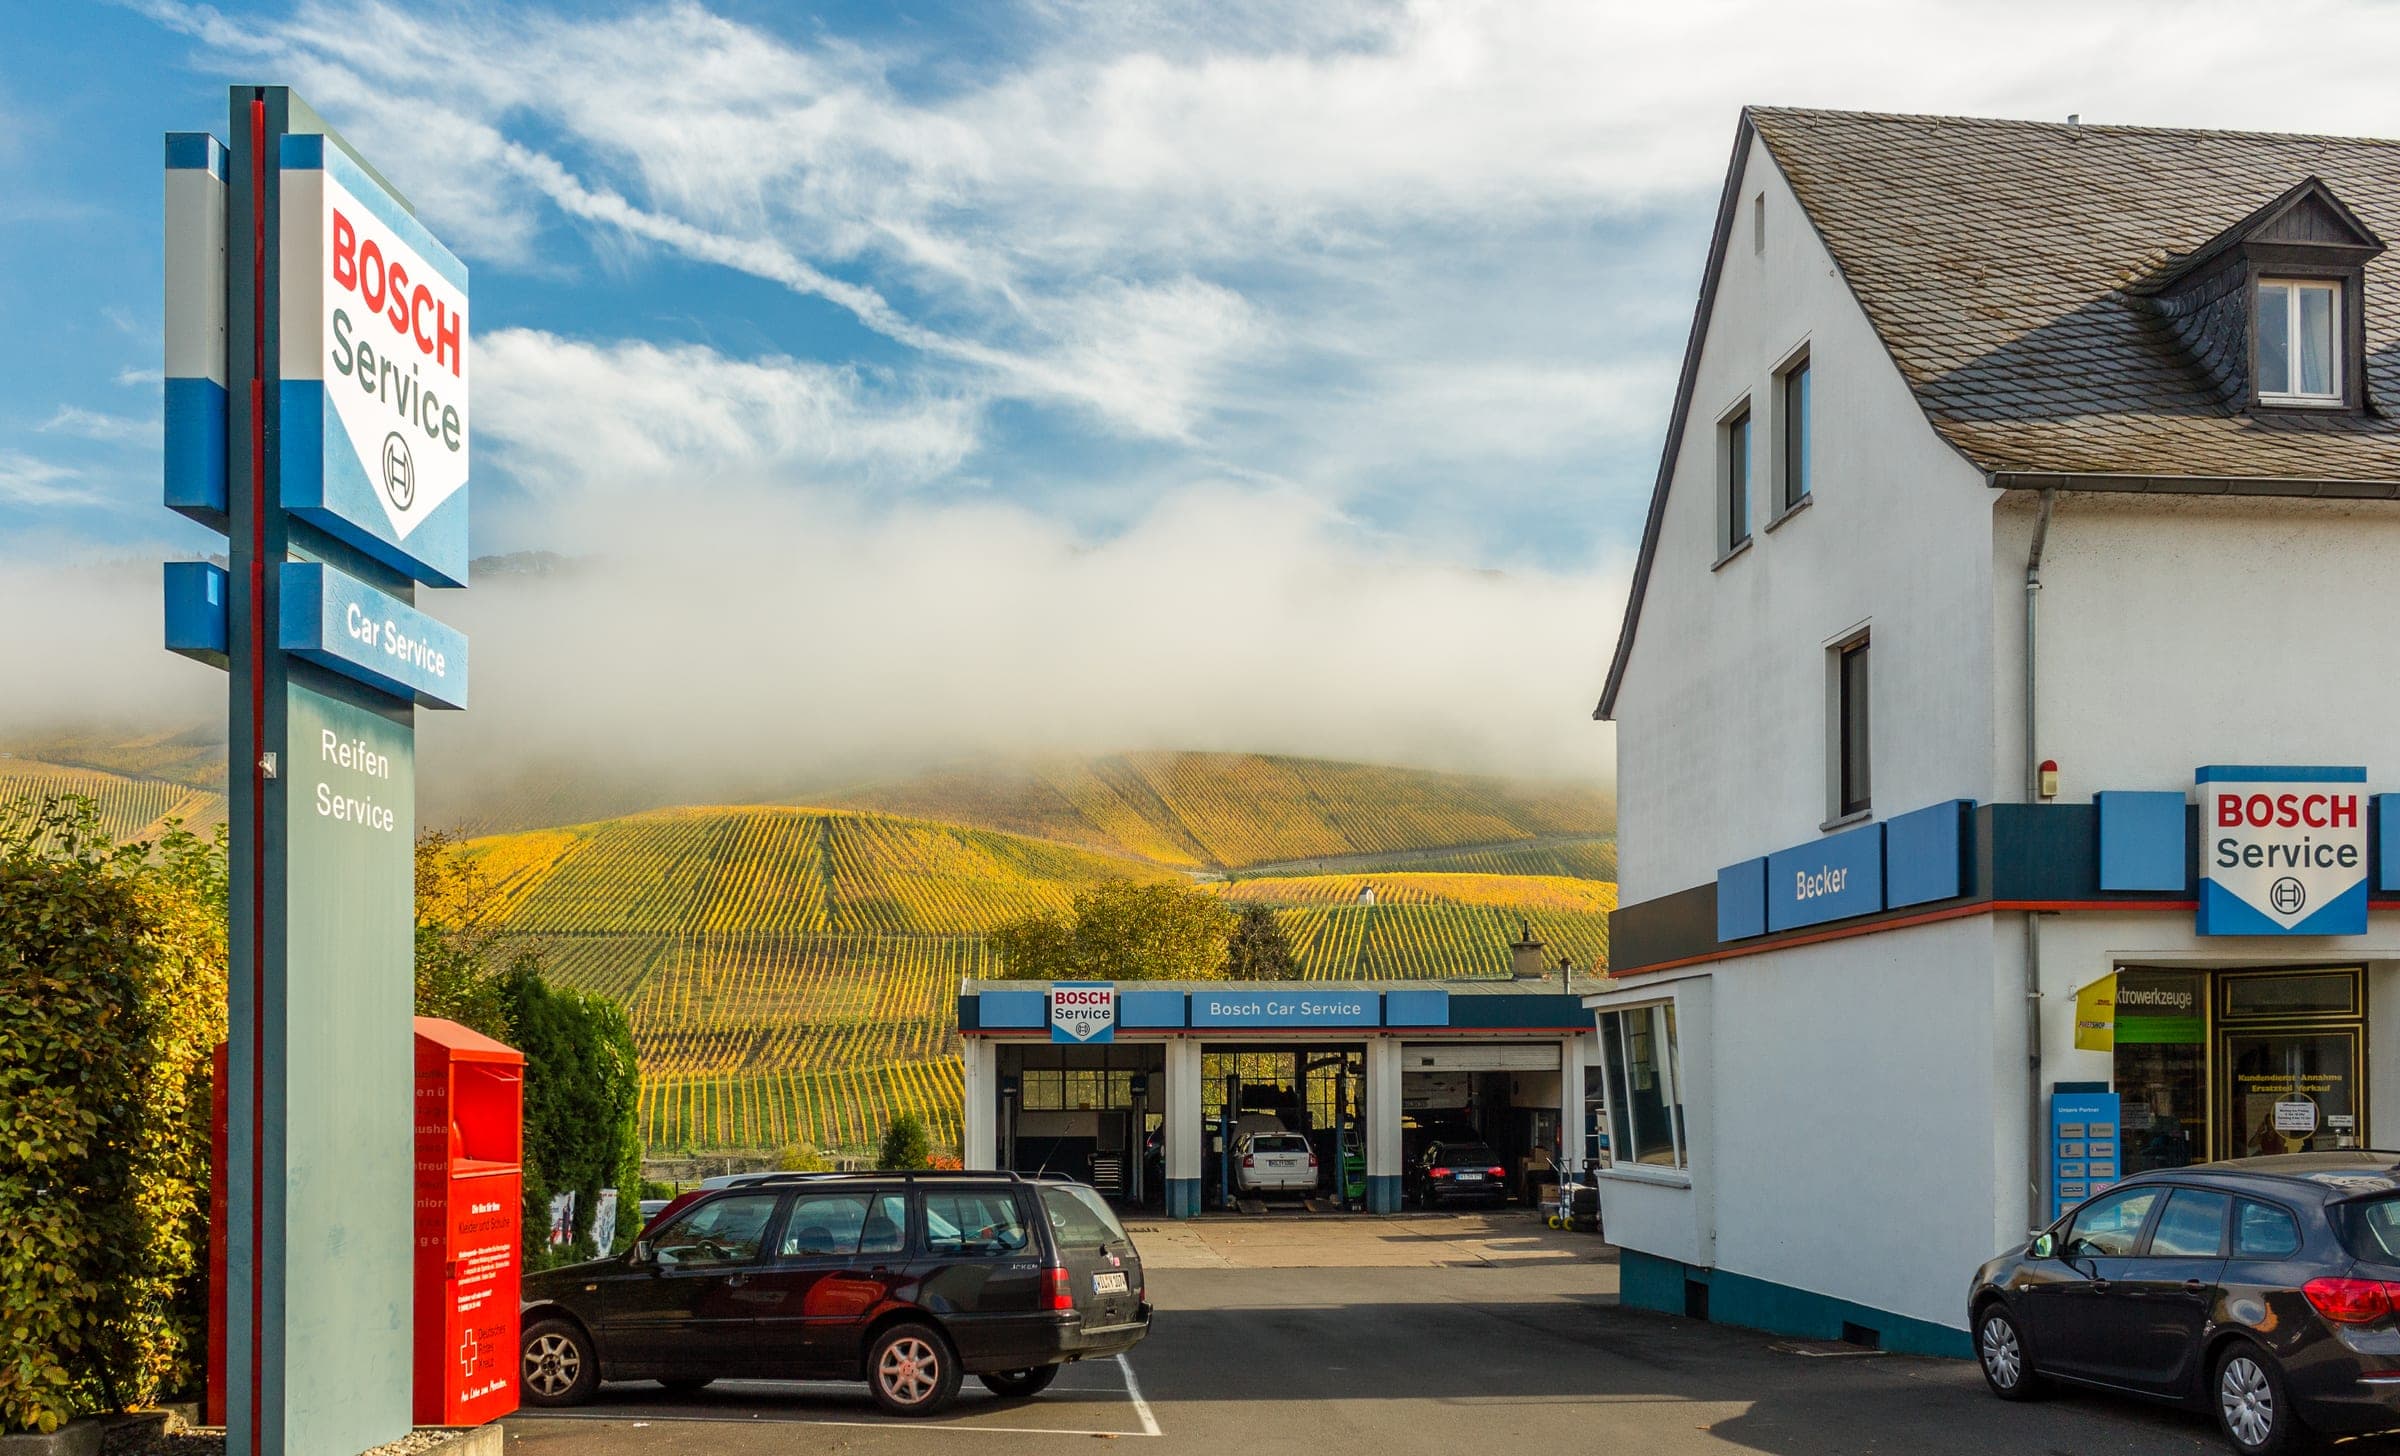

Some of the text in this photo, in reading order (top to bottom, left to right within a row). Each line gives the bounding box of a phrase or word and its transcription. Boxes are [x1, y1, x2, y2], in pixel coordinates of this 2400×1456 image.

[333, 207, 460, 378] BOSCH
[331, 308, 460, 452] Service
[347, 602, 445, 678] Car Service
[322, 728, 388, 779] Reifen
[317, 782, 393, 832] Service
[2218, 794, 2357, 828] BOSCH
[2216, 836, 2358, 868] Service
[1797, 864, 1848, 900] Becker
[1055, 992, 1111, 1005] BOSCH
[1055, 1007, 1111, 1020] Service
[1210, 1002, 1361, 1016] Bosch Car Service
